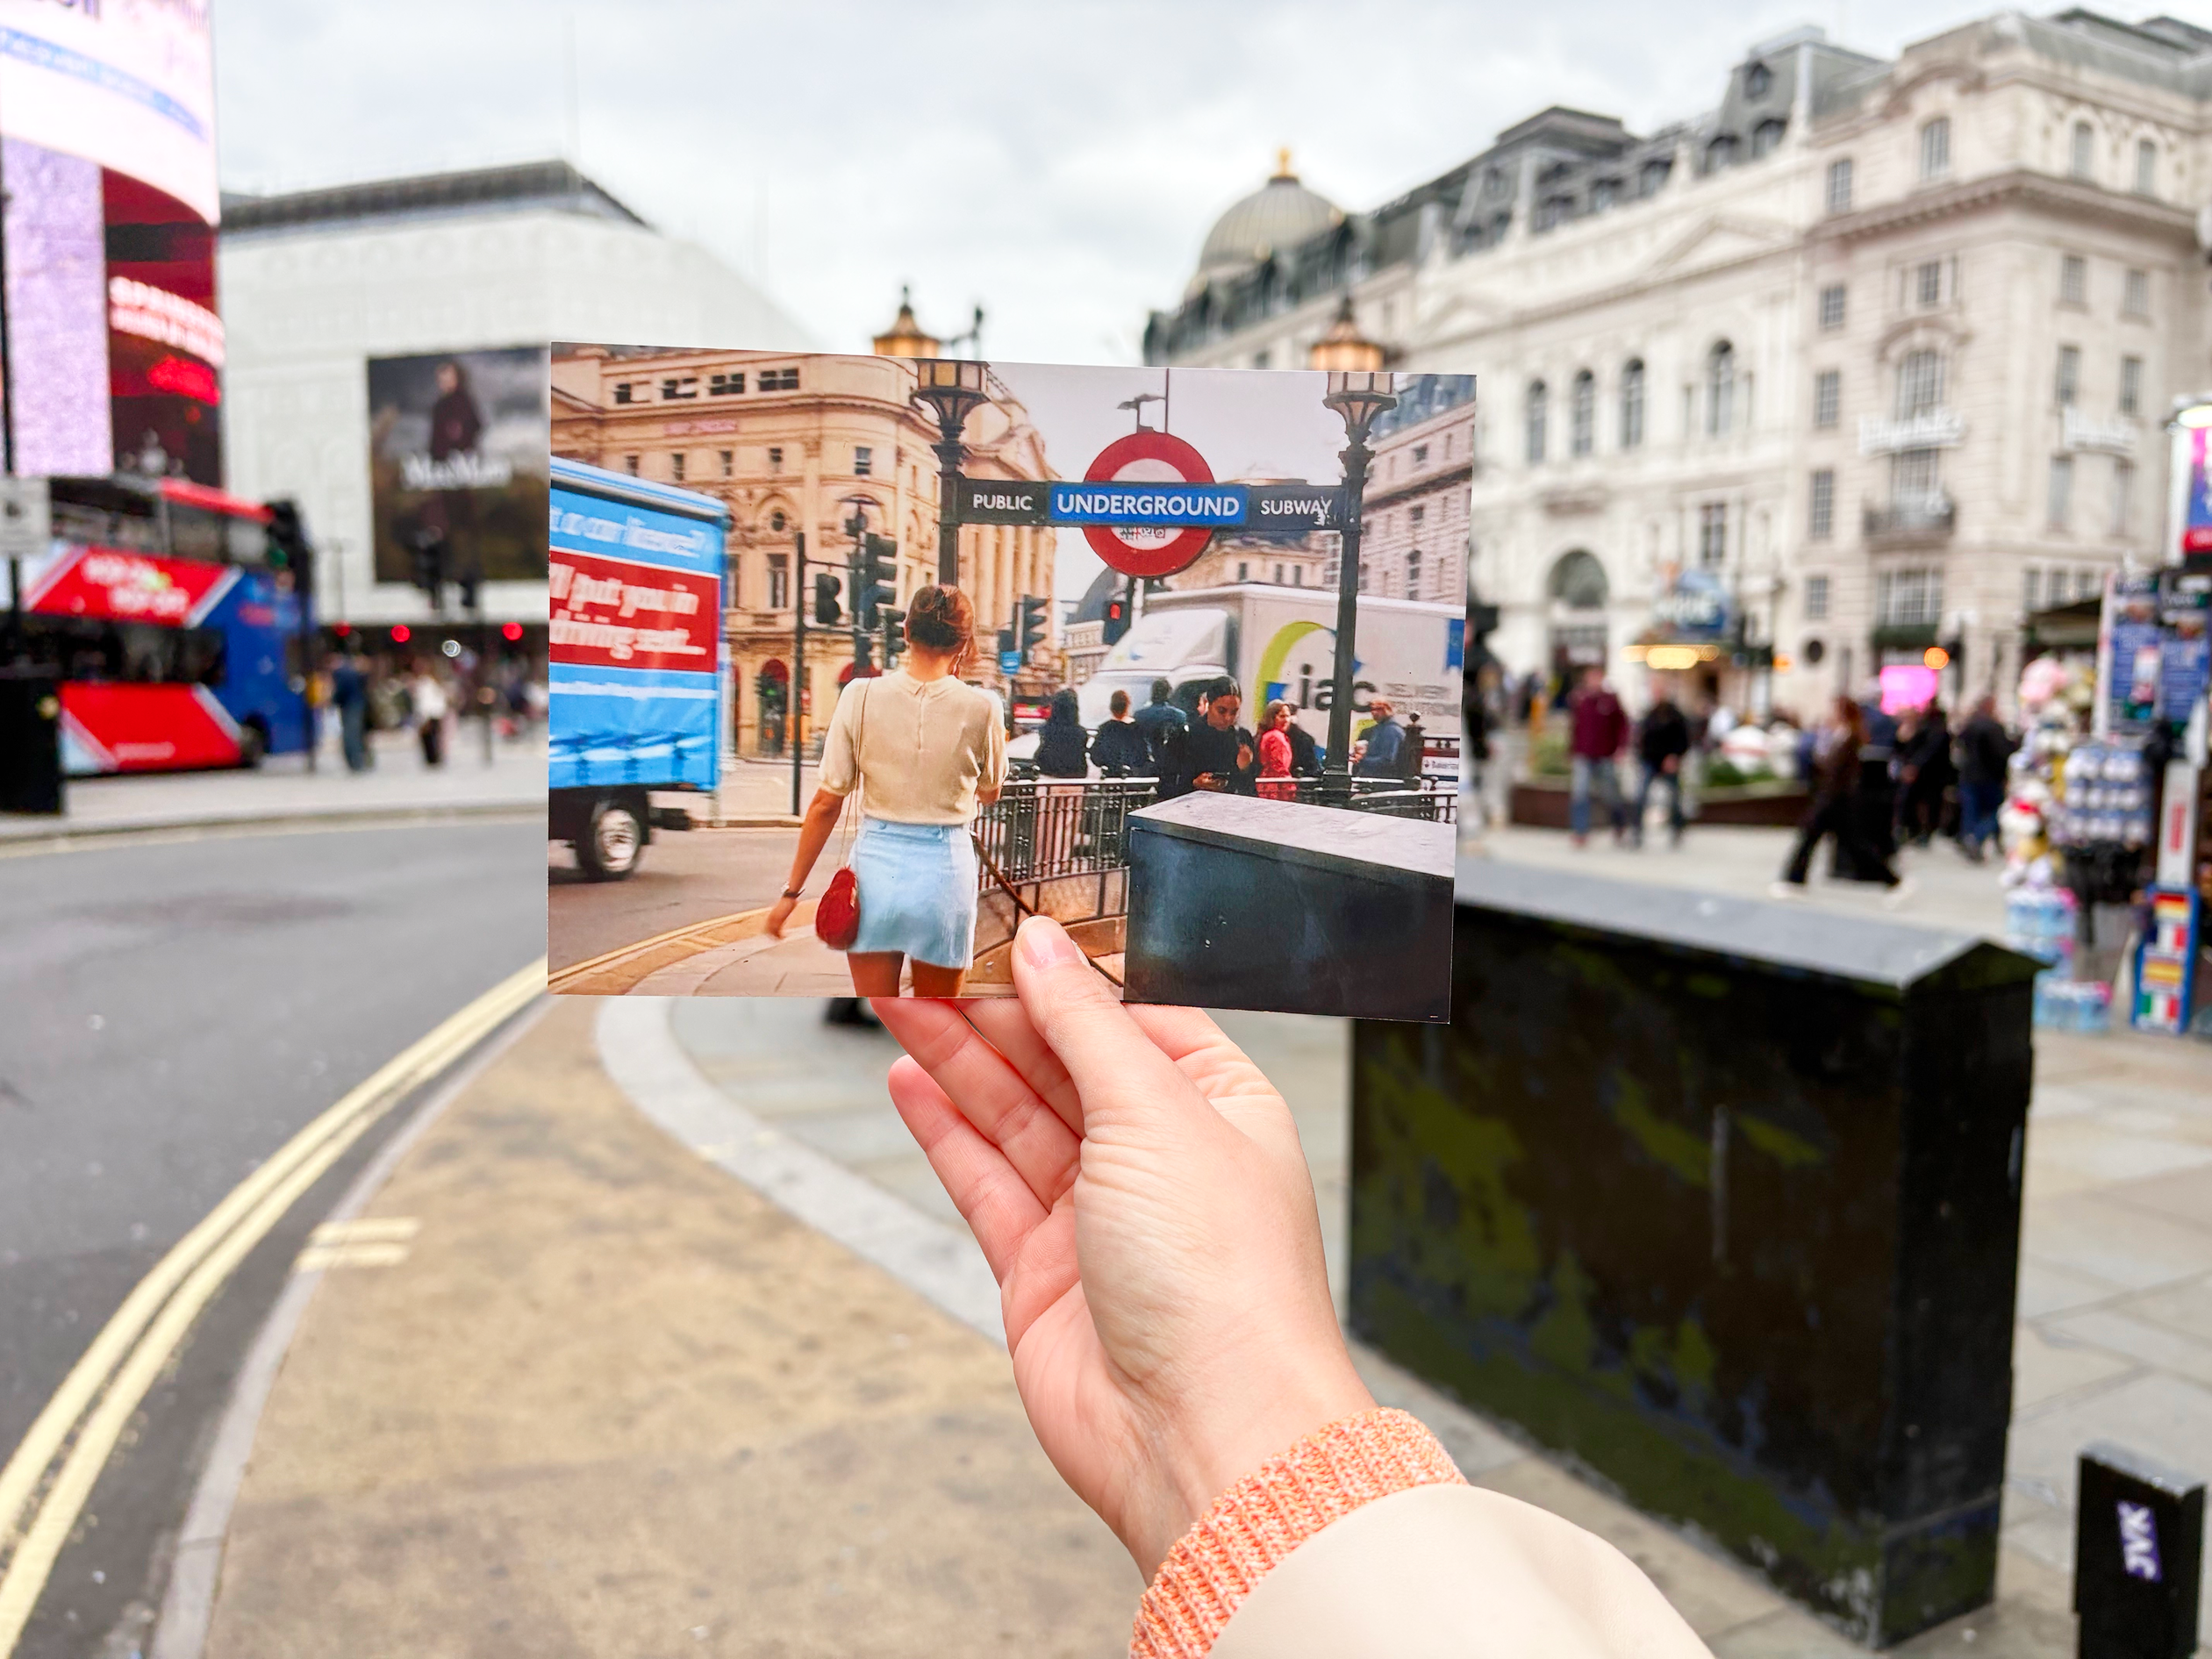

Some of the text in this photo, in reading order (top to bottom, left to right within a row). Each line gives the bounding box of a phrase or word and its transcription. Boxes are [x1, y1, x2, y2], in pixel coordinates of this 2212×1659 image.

[972, 493, 1333, 518] PUBLIC UNDERGROUND SUBWAY
